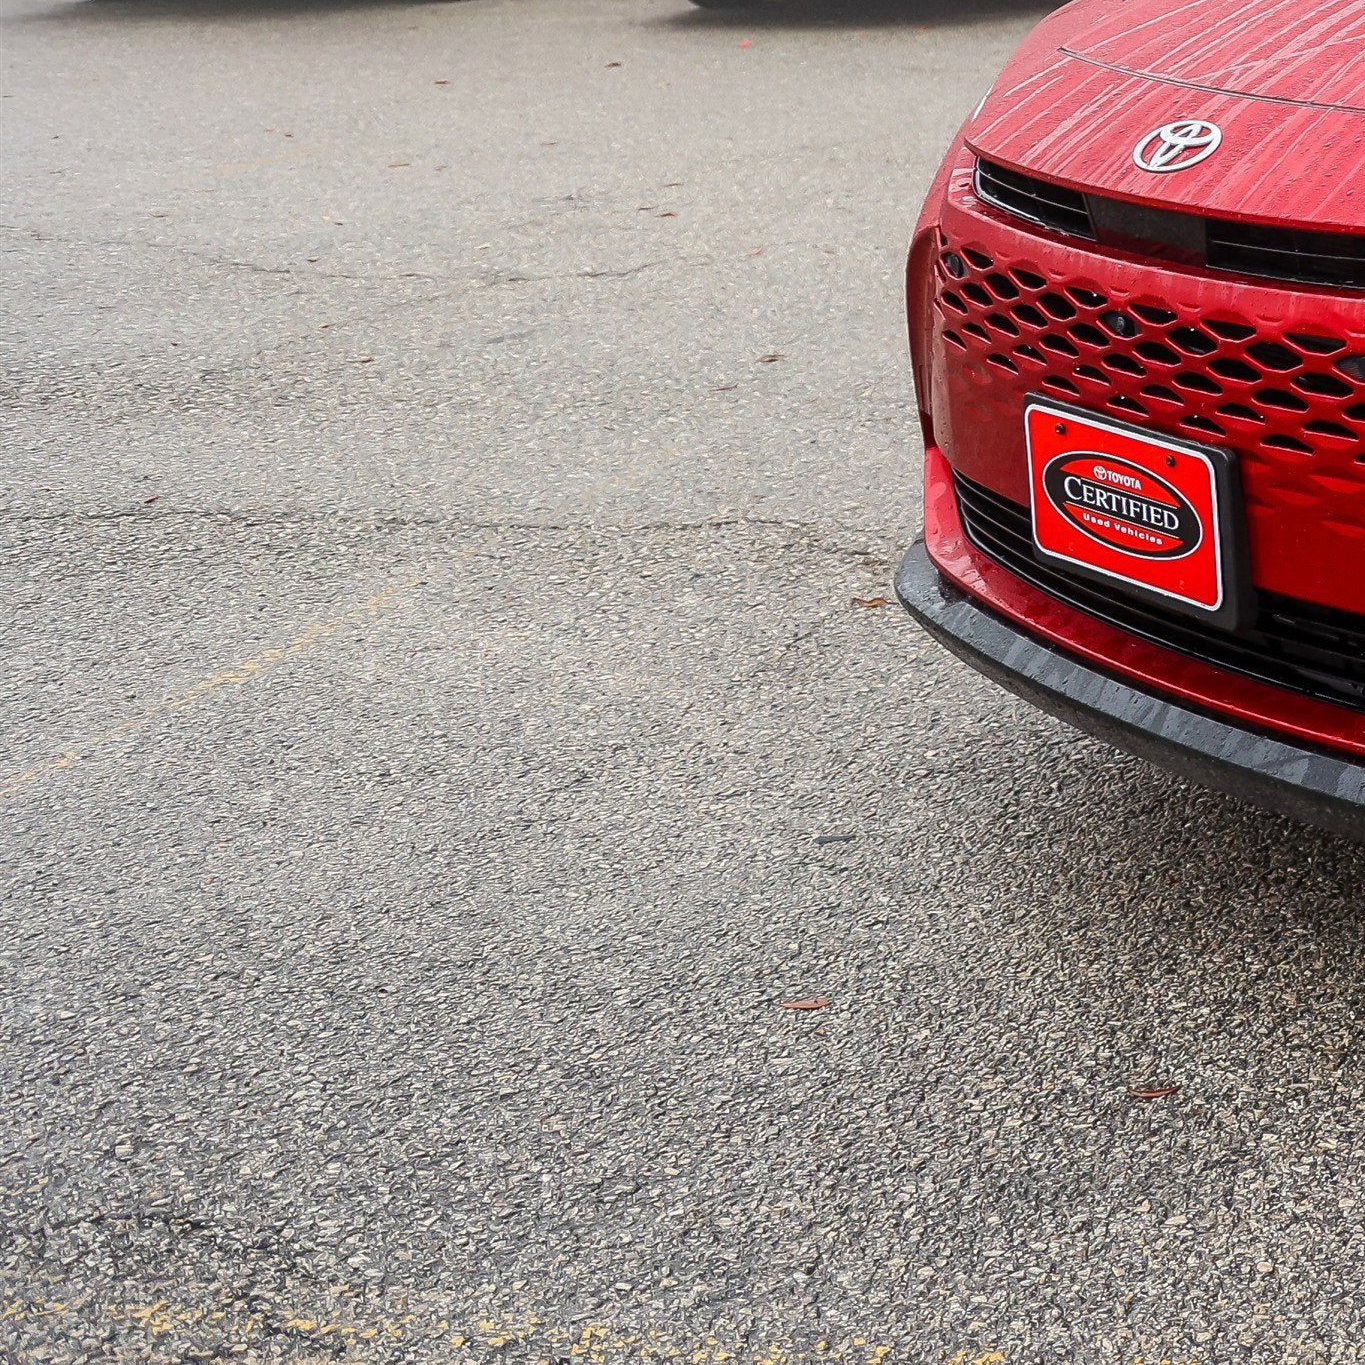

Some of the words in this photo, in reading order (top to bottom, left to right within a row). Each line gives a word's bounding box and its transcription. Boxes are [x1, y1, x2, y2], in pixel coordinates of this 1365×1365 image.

[1106, 470, 1142, 490] TOYOTA
[1063, 476, 1179, 530] CERTIFIED
[1083, 512, 1110, 528] Used
[1114, 523, 1163, 546] Vehicles
